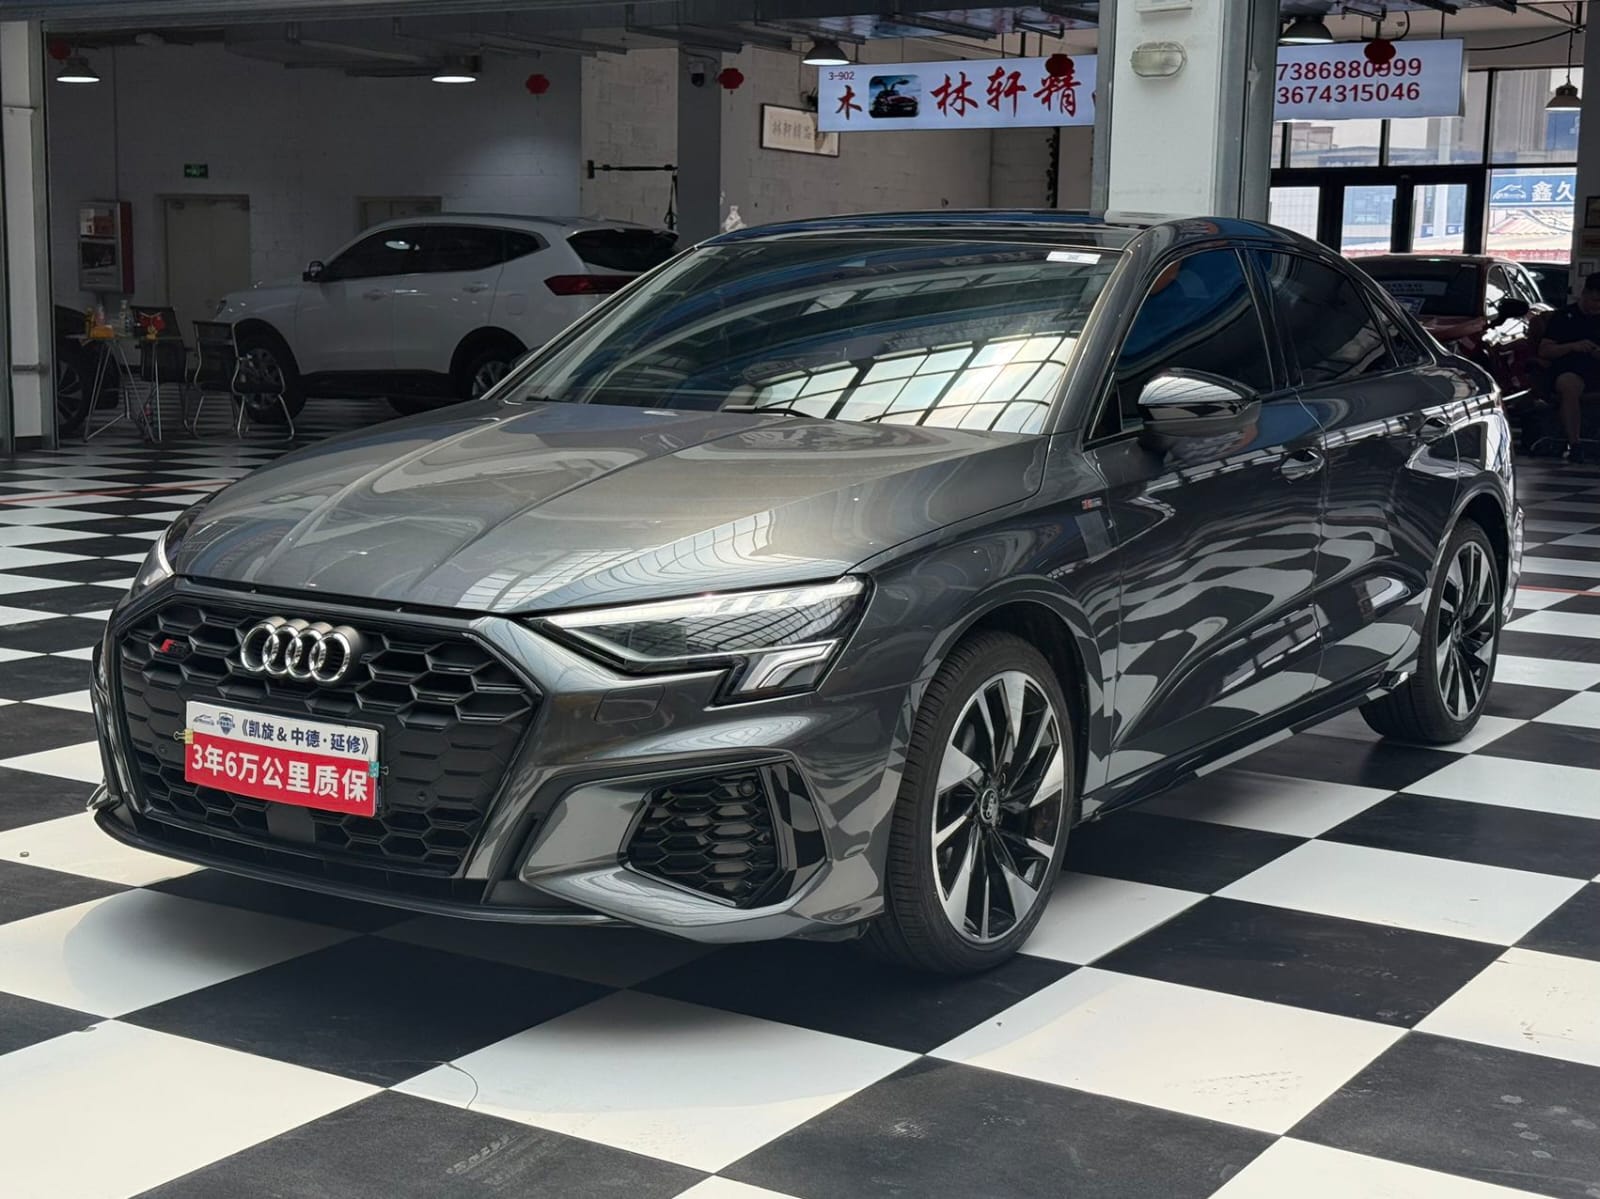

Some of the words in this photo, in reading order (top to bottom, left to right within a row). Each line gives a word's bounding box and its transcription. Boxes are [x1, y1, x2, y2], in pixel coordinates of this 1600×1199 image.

[828, 71, 855, 81] 3-902
[835, 84, 863, 121] 木
[931, 66, 1097, 118] 林轩精
[1277, 82, 1420, 105] 3674315046
[1531, 180, 1575, 202] 鑫久
[192, 744, 368, 803] 3年6万公里质保
